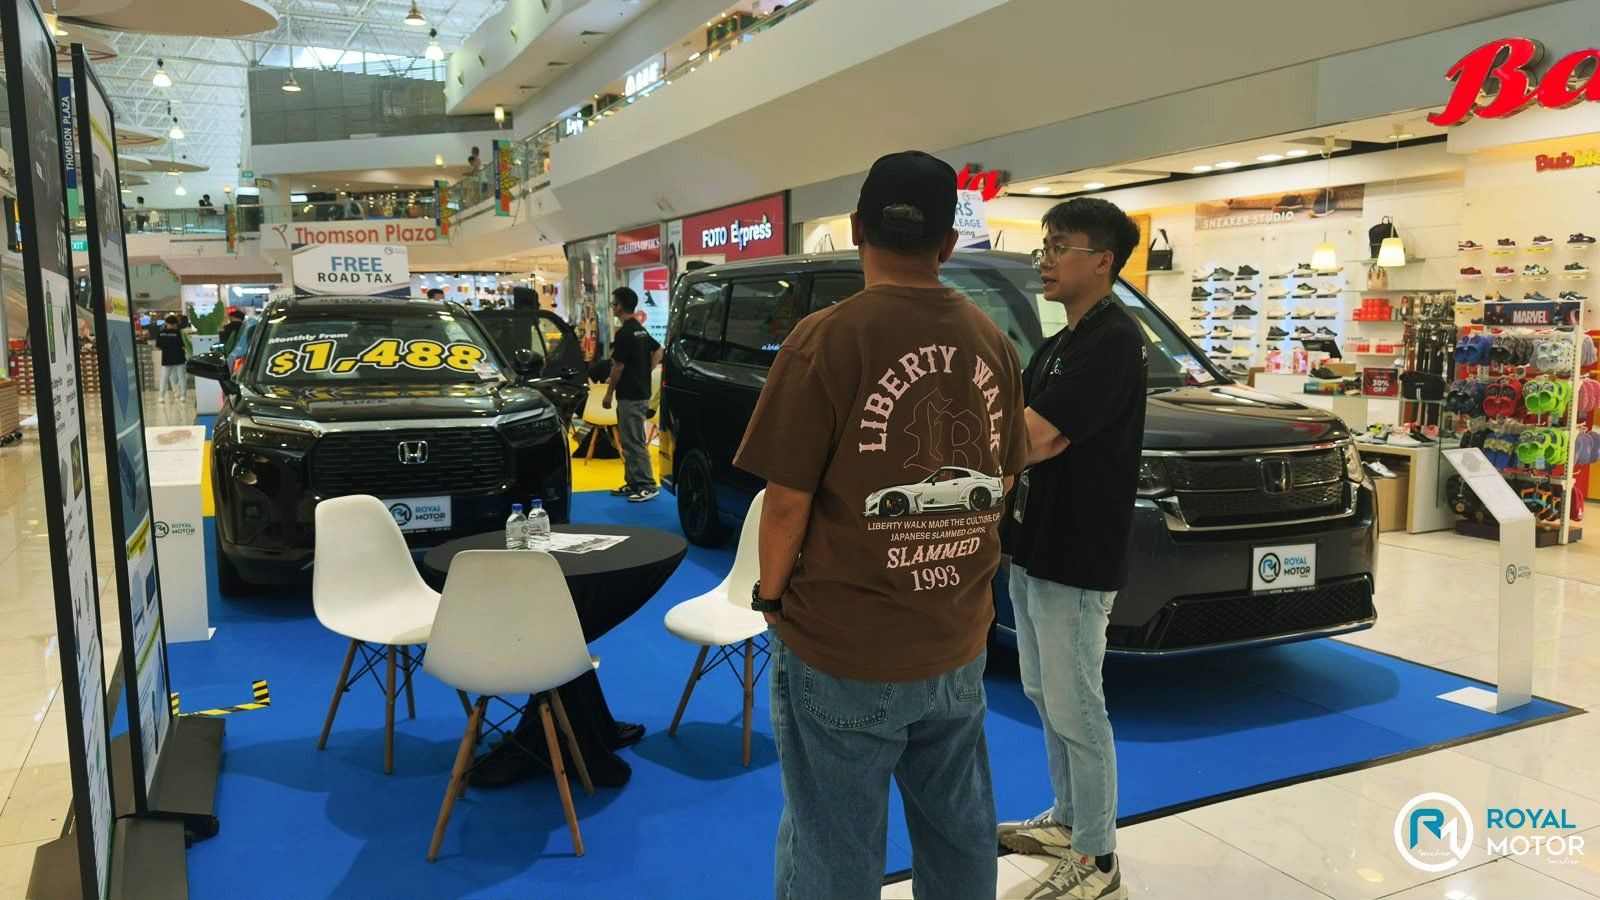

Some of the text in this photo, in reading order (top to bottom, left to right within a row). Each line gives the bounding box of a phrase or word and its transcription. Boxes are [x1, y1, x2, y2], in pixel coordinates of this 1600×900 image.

[61, 96, 74, 171] THOMSON PLAZA
[957, 163, 1003, 202] ta
[955, 202, 973, 217] RS
[955, 219, 982, 228] LEAGE
[1203, 211, 1295, 229] SNEAKER STUDIO
[295, 223, 437, 244] Thomson Plaza
[702, 218, 772, 252] FOTO Express
[959, 230, 976, 239] icing
[72, 241, 84, 249] XIT
[331, 256, 383, 272] FREE
[317, 272, 393, 284] ROAD TAX
[1513, 310, 1548, 323] MARVEL
[268, 334, 316, 345] Monthly
[266, 338, 487, 377] $1,488
[859, 344, 1003, 453] LIBERTY WALK
[415, 505, 441, 513] ROYAL
[415, 512, 446, 521] MOTOR
[867, 521, 902, 531] LIBERTY
[903, 520, 927, 529] WALK
[928, 519, 950, 529] MADE
[950, 518, 965, 527] THE
[966, 514, 992, 525] CULTURE
[890, 531, 931, 541] JAPANESE
[931, 528, 966, 540] SLAMMED
[886, 537, 980, 569] SLAMMED
[1284, 556, 1307, 566] ROYAL
[911, 564, 960, 591] 1993
[1284, 566, 1311, 576] MOTOR
